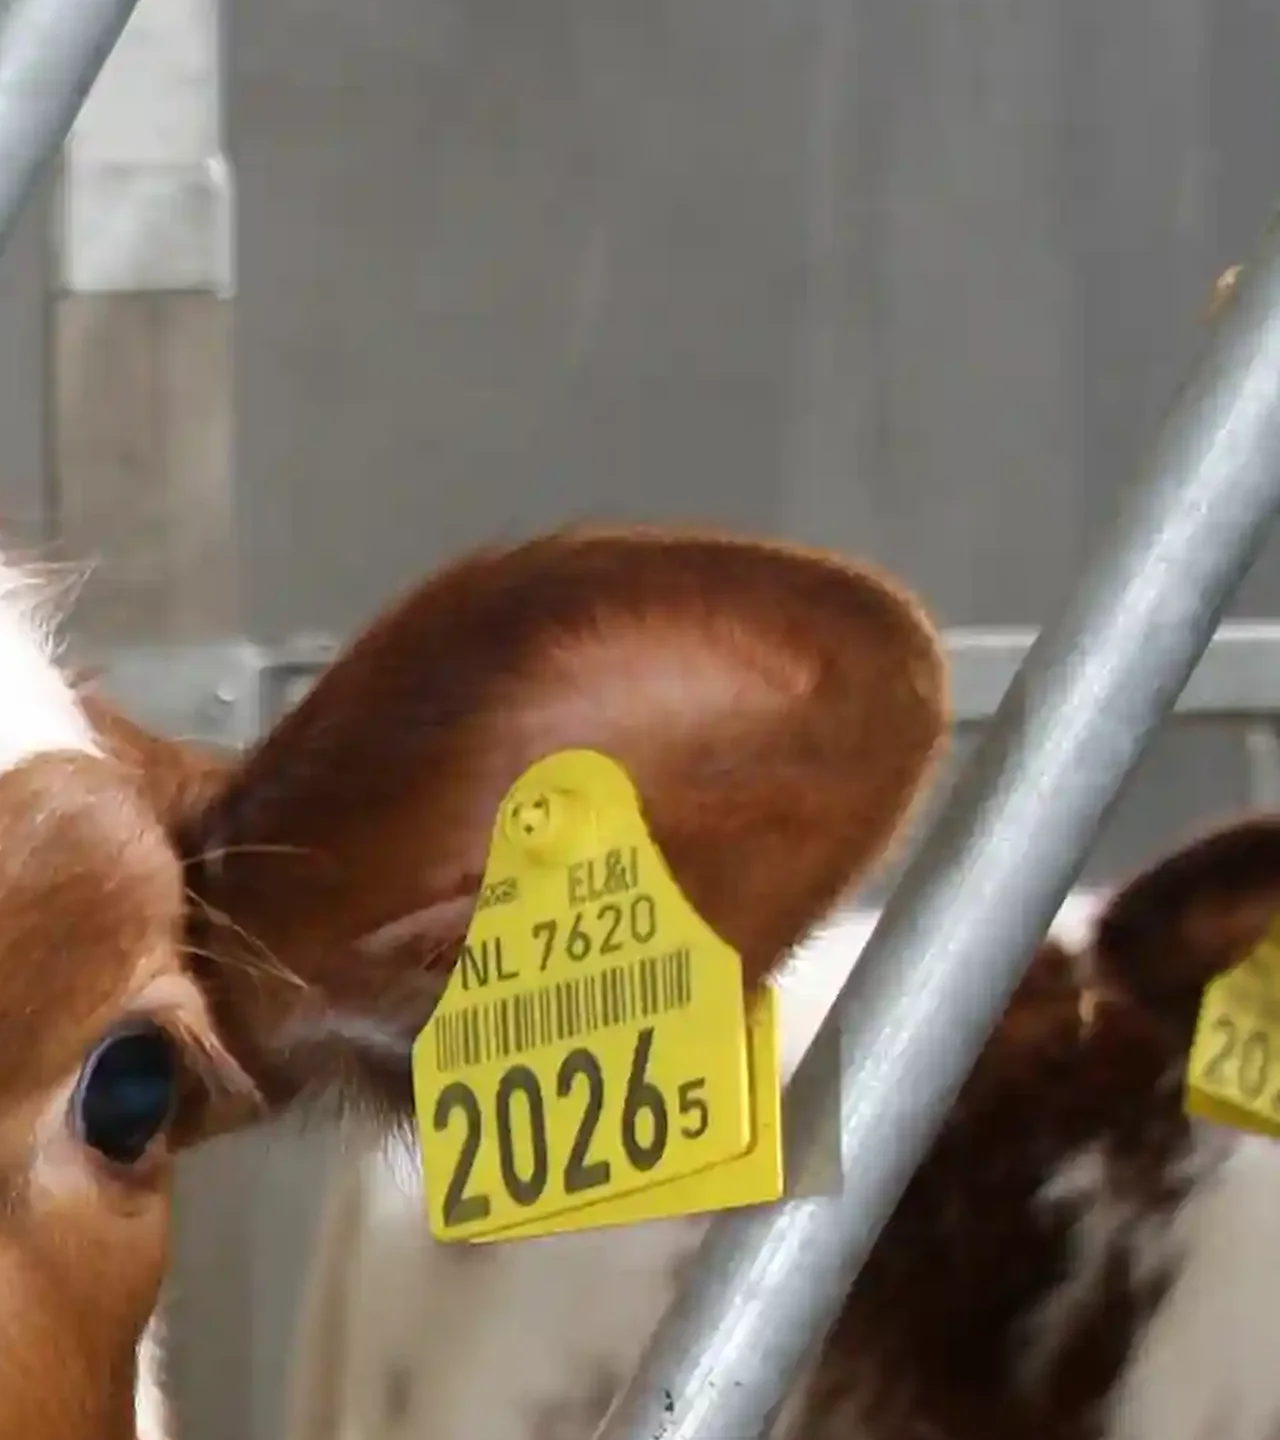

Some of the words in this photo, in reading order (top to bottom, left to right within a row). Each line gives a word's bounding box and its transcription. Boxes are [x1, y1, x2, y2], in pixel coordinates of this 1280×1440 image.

[460, 936, 520, 991] NL
[532, 894, 656, 971] 7620
[1203, 1013, 1280, 1116] 20
